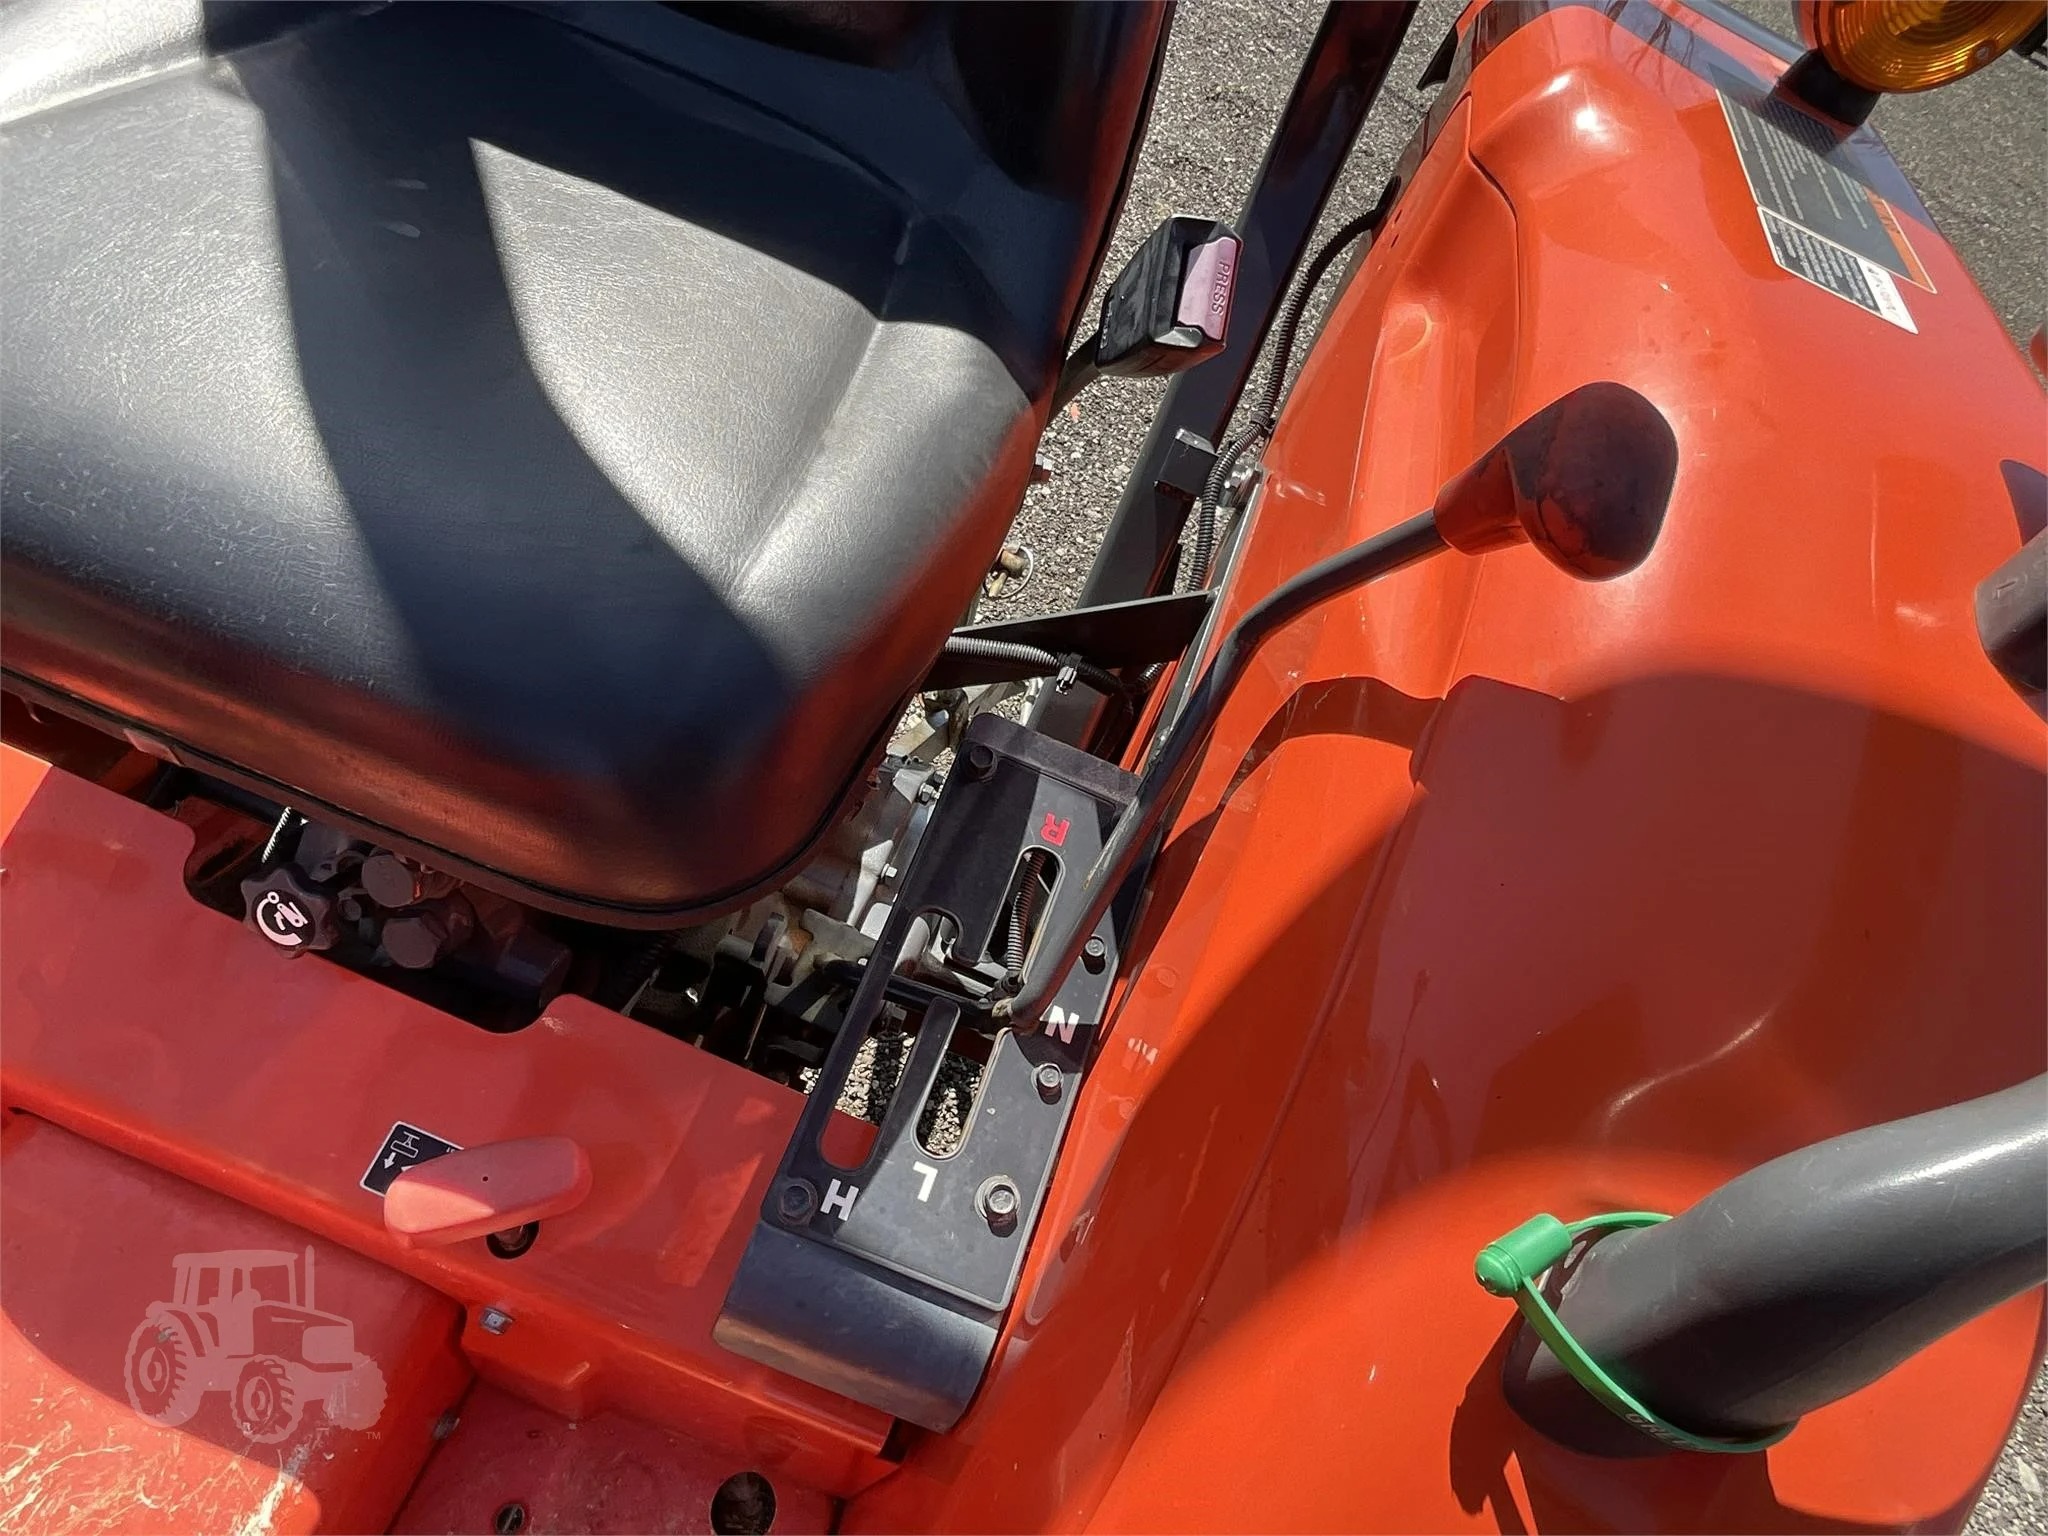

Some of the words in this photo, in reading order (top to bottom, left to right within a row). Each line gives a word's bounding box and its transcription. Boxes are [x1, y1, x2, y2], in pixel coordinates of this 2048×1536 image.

[1211, 261, 1230, 316] PRESS
[1039, 813, 1071, 845] R
[1044, 1005, 1079, 1044] N
[819, 1178, 859, 1221] H
[913, 1161, 938, 1202] L
